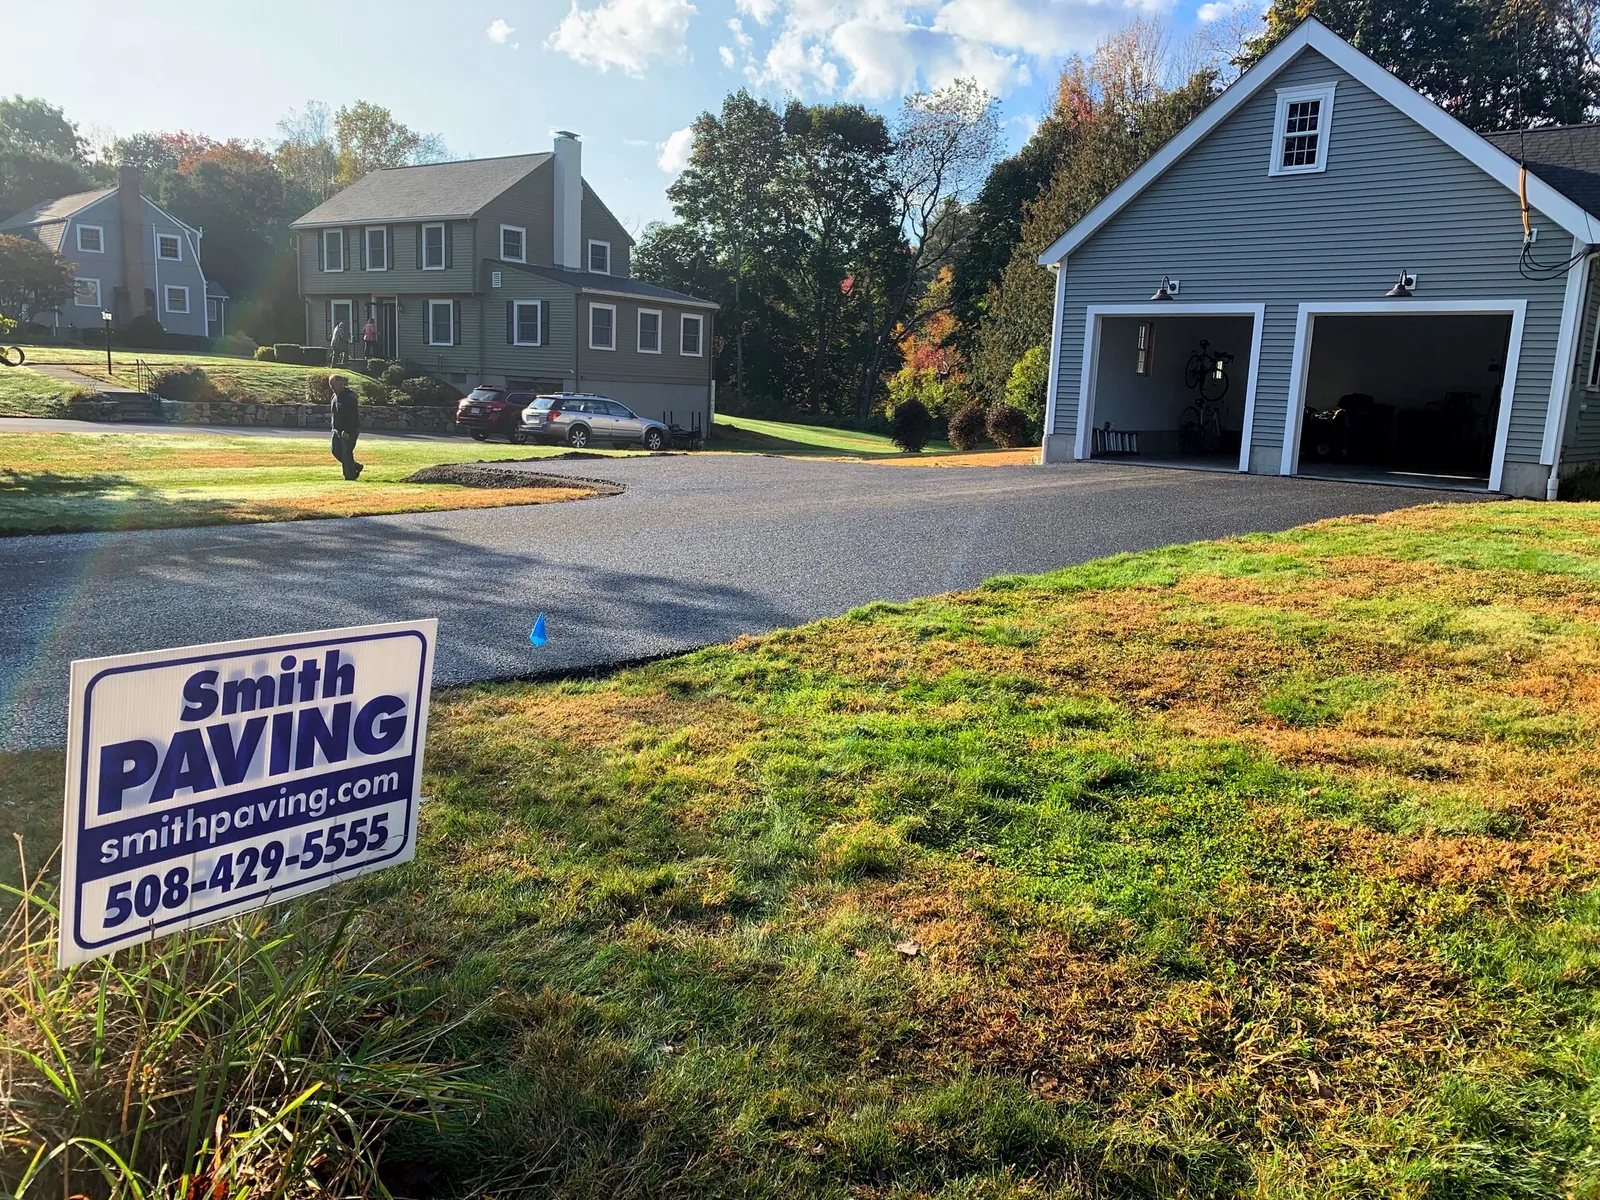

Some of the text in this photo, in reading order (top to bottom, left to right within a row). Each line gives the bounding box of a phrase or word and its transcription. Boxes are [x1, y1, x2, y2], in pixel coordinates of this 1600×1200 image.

[180, 649, 356, 722] Smith
[97, 694, 408, 816] PAVING
[99, 771, 399, 865] smithpaving.com
[102, 812, 389, 929] 508-429-5555
